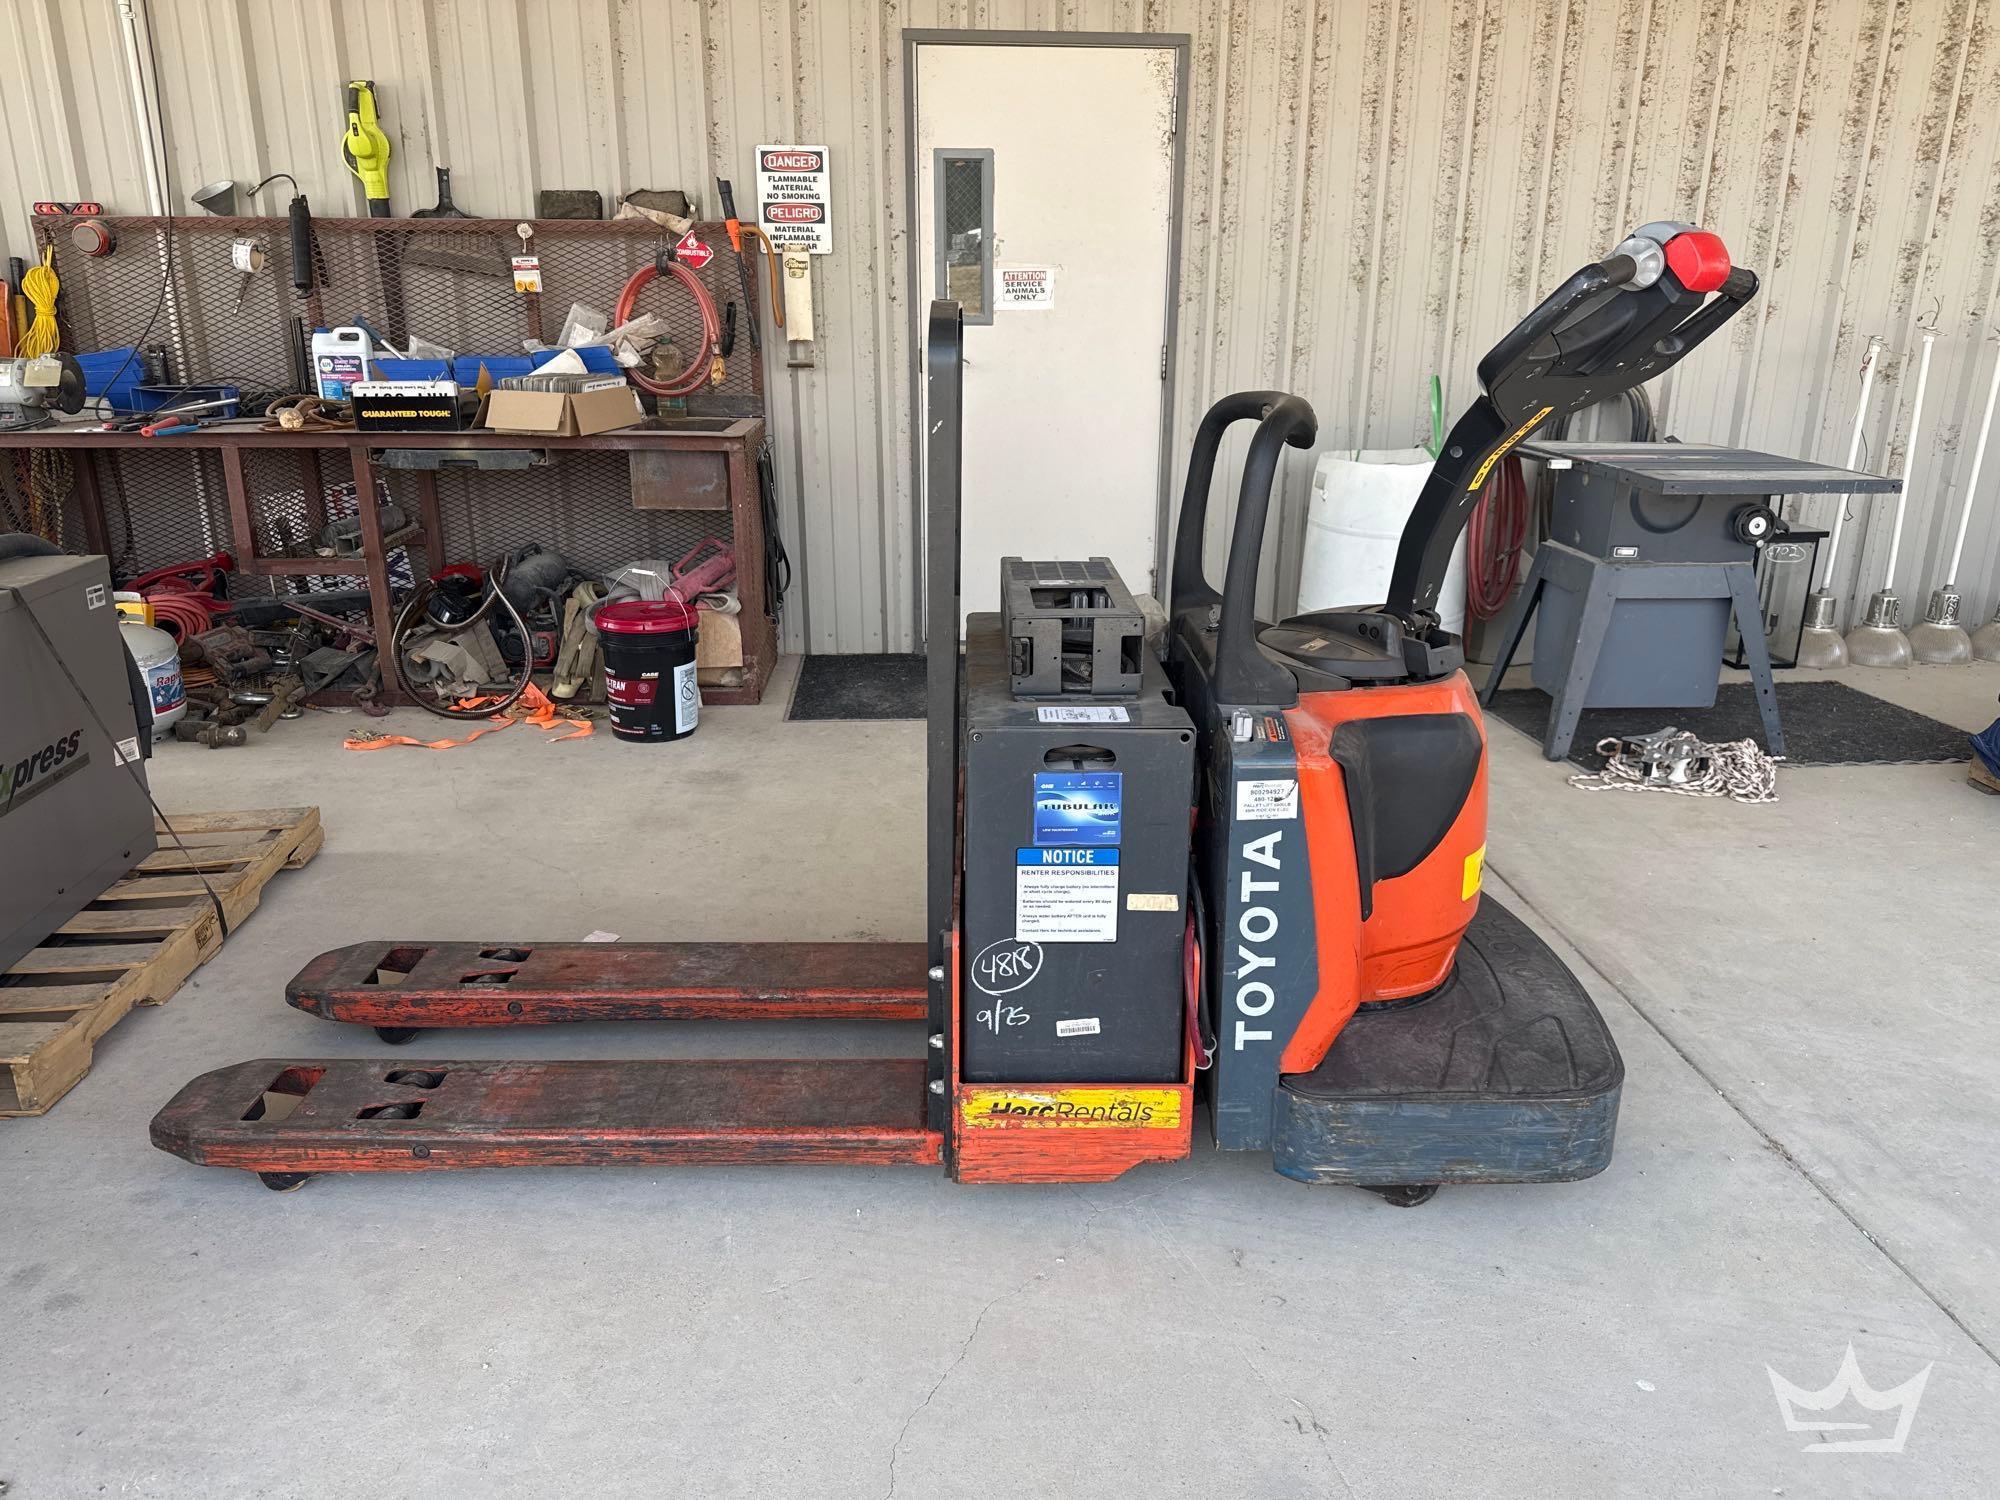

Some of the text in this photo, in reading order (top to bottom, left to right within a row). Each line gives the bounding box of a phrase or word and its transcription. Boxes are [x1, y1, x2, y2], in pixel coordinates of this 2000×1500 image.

[768, 156, 817, 167] DANGER
[768, 175, 818, 183] FLAMMABLE
[772, 184, 814, 192] MATERIAL
[770, 207, 819, 218] PELIGRO
[1004, 271, 1046, 280] ATTENTION
[361, 410, 418, 418] GUARANTEED
[1043, 803, 1115, 811] TUBULAR
[1042, 849, 1094, 864] NOTICE
[1234, 830, 1283, 1051] TOYOTA
